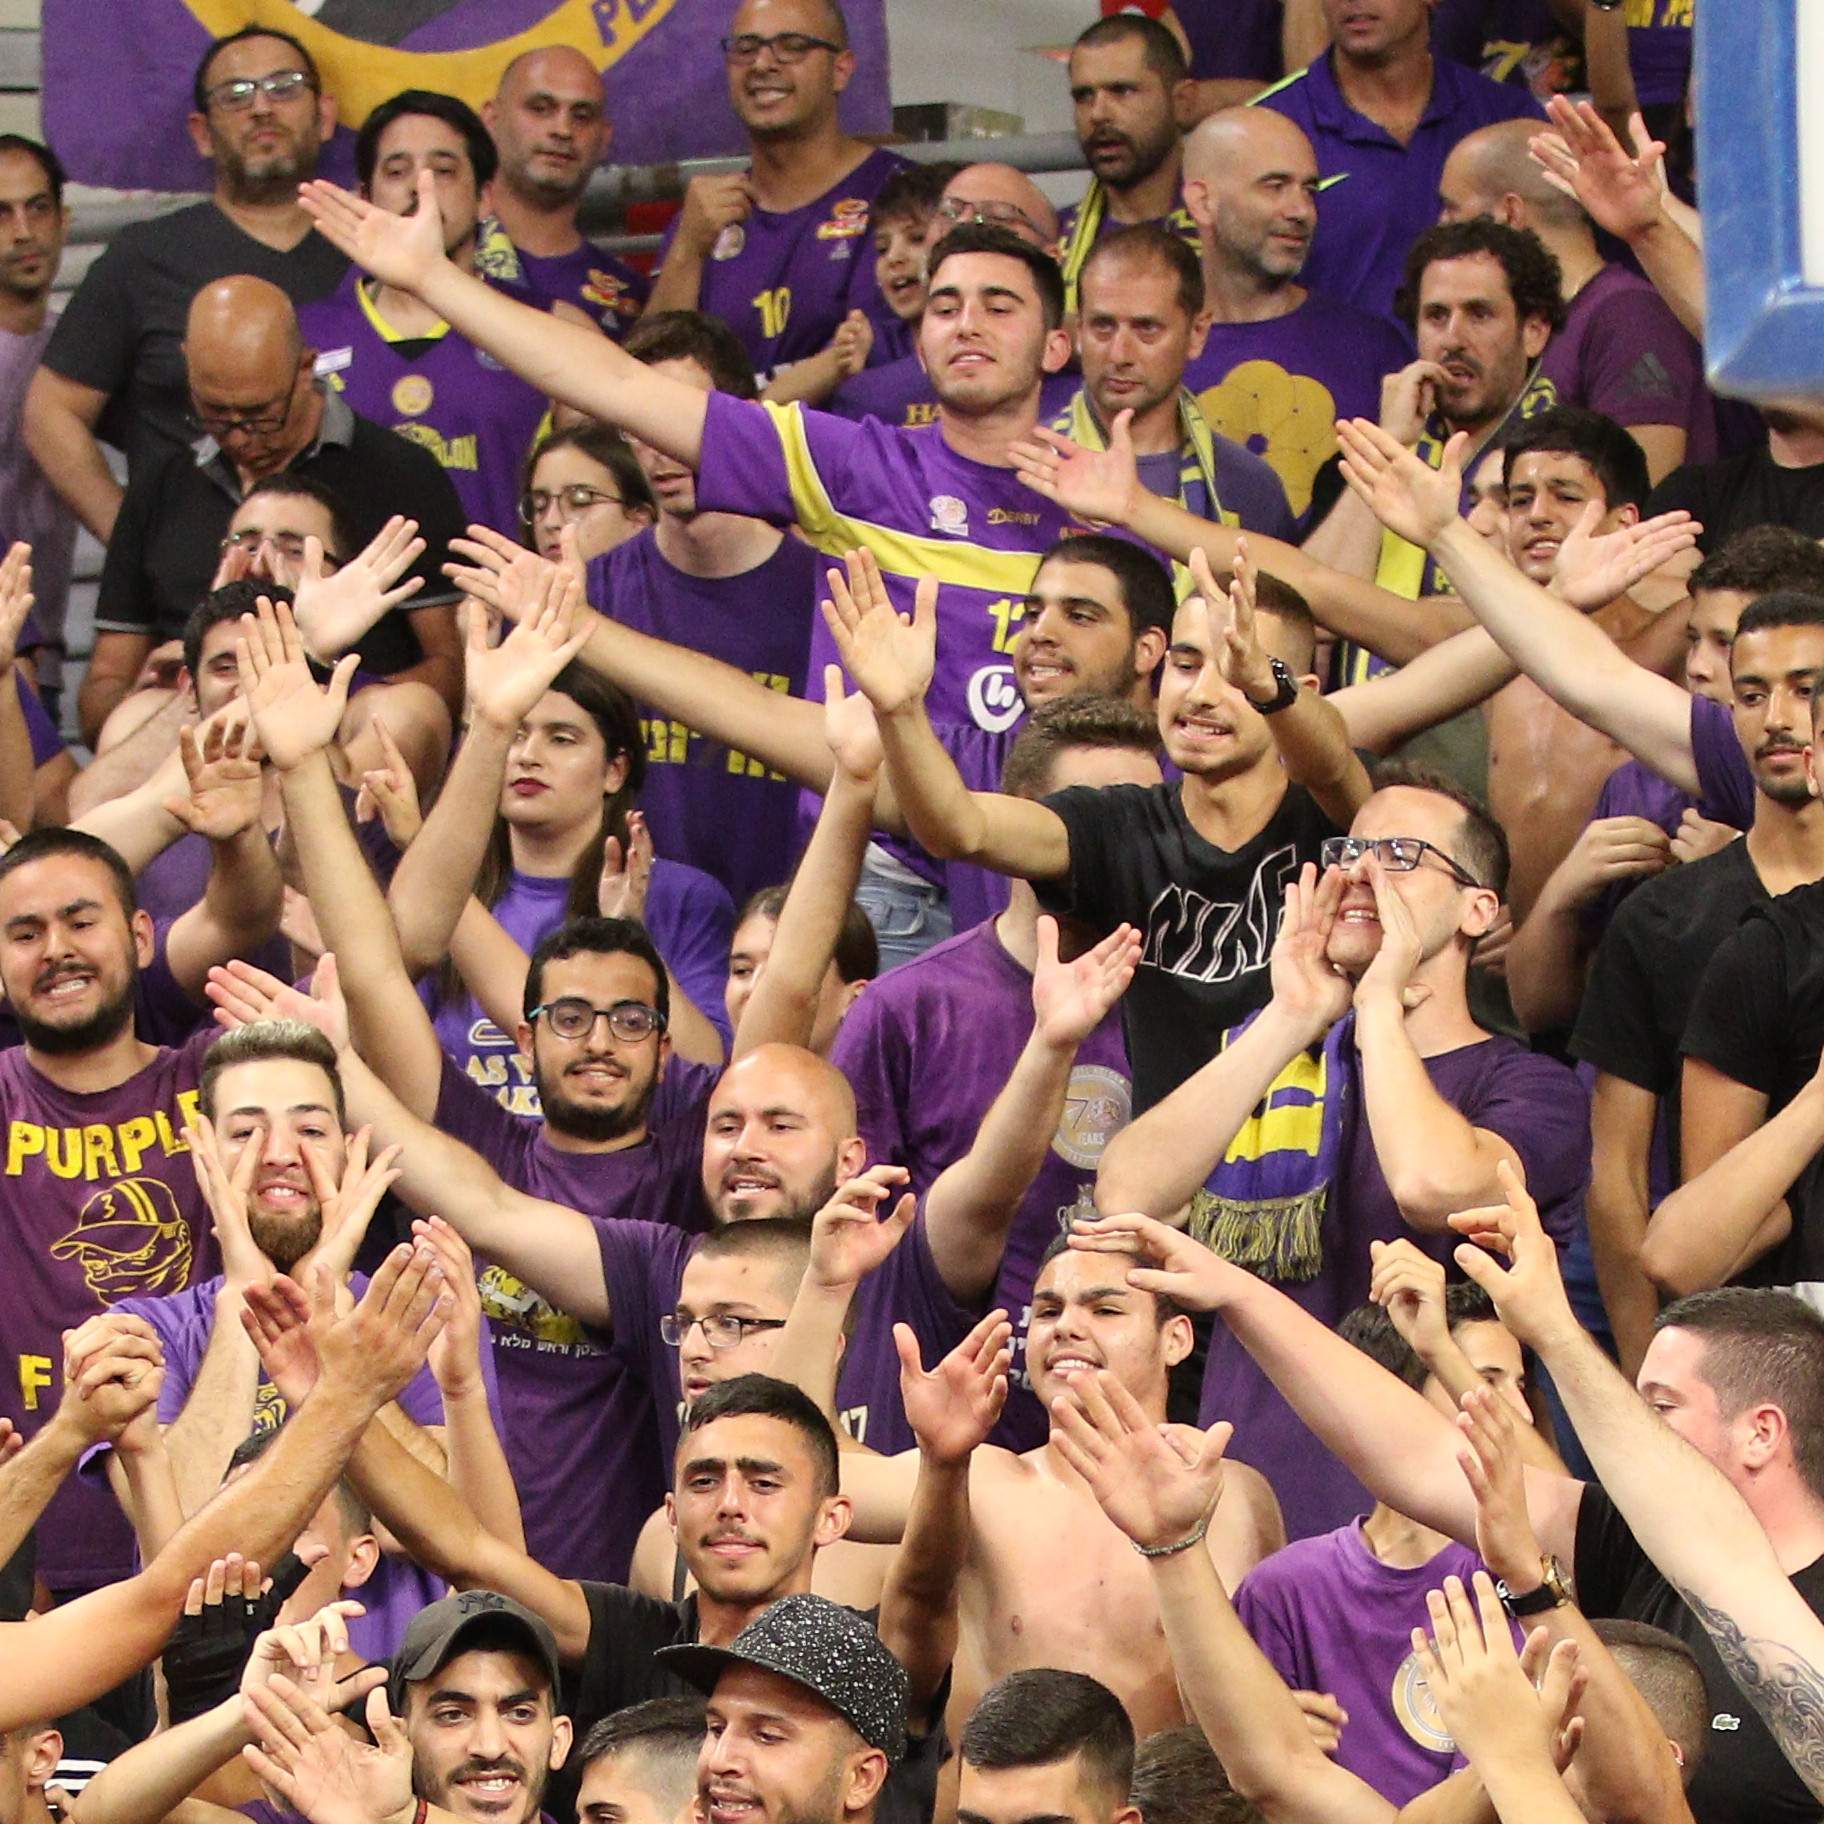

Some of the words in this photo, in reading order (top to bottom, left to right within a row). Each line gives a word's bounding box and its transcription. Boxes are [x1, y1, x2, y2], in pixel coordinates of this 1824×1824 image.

[1482, 40, 1531, 83] 7
[752, 287, 792, 338] 10
[101, 1193, 116, 1219] 3
[500, 1333, 532, 1350] מלא
